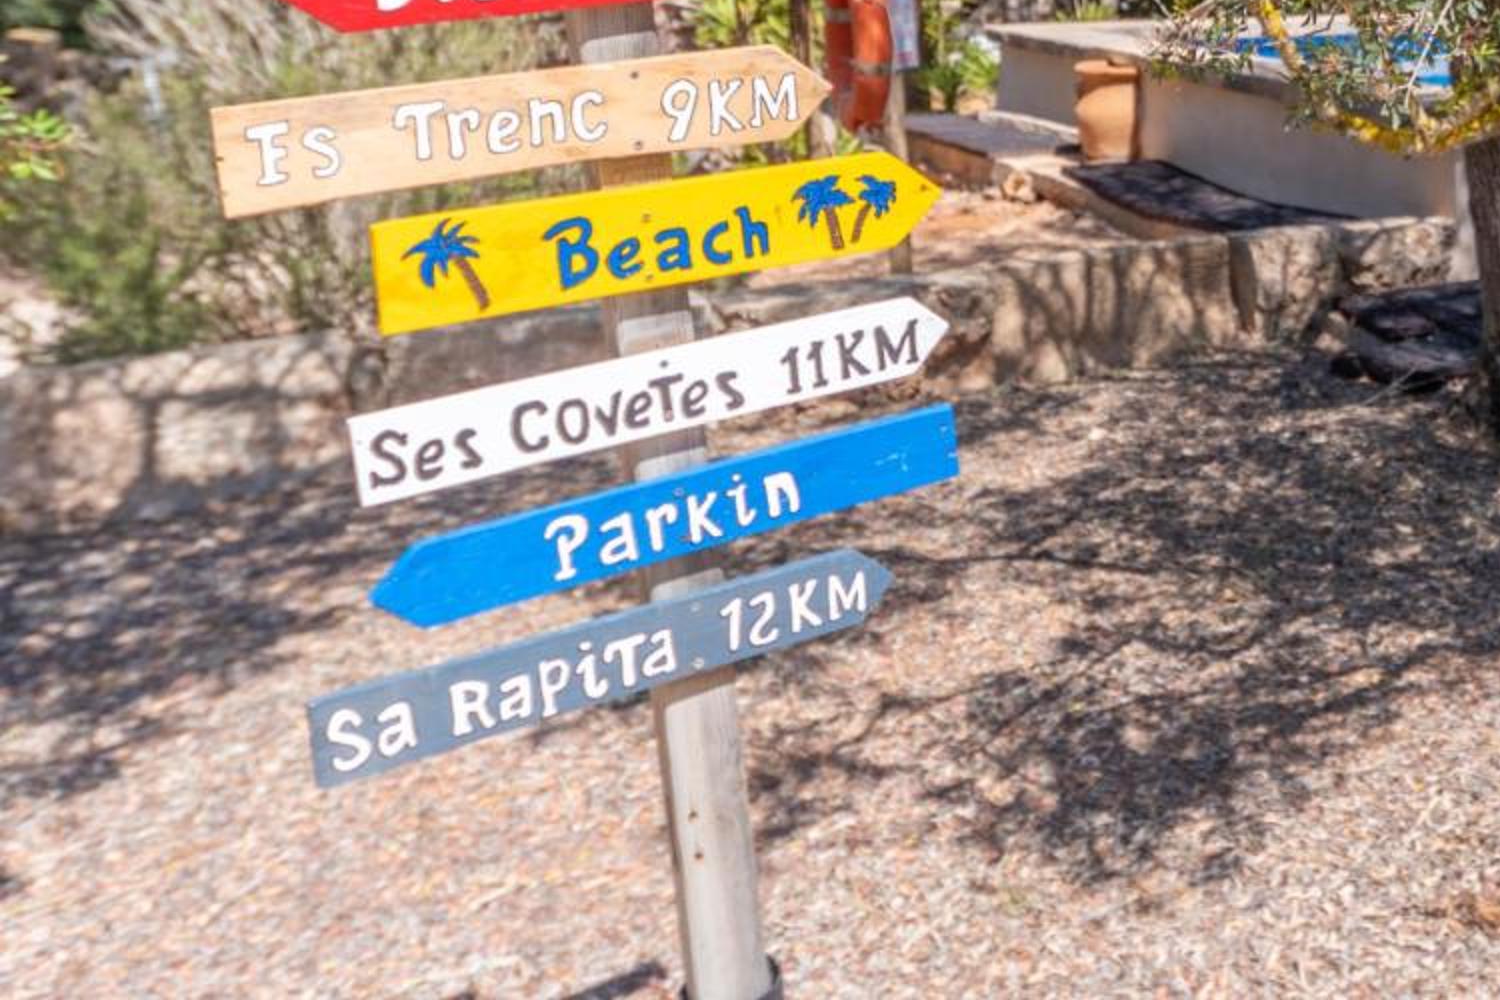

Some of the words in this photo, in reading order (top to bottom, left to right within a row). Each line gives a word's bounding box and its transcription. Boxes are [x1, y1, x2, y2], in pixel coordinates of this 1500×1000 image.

[246, 122, 341, 187] Es
[392, 91, 608, 160] Trenc
[661, 73, 800, 143] 9KM
[544, 207, 770, 289] Beach
[369, 428, 484, 490] Ses
[780, 318, 921, 394] 11KM
[543, 471, 801, 580] Parkin
[325, 701, 418, 773] Sa
[719, 569, 868, 651] 12KM
